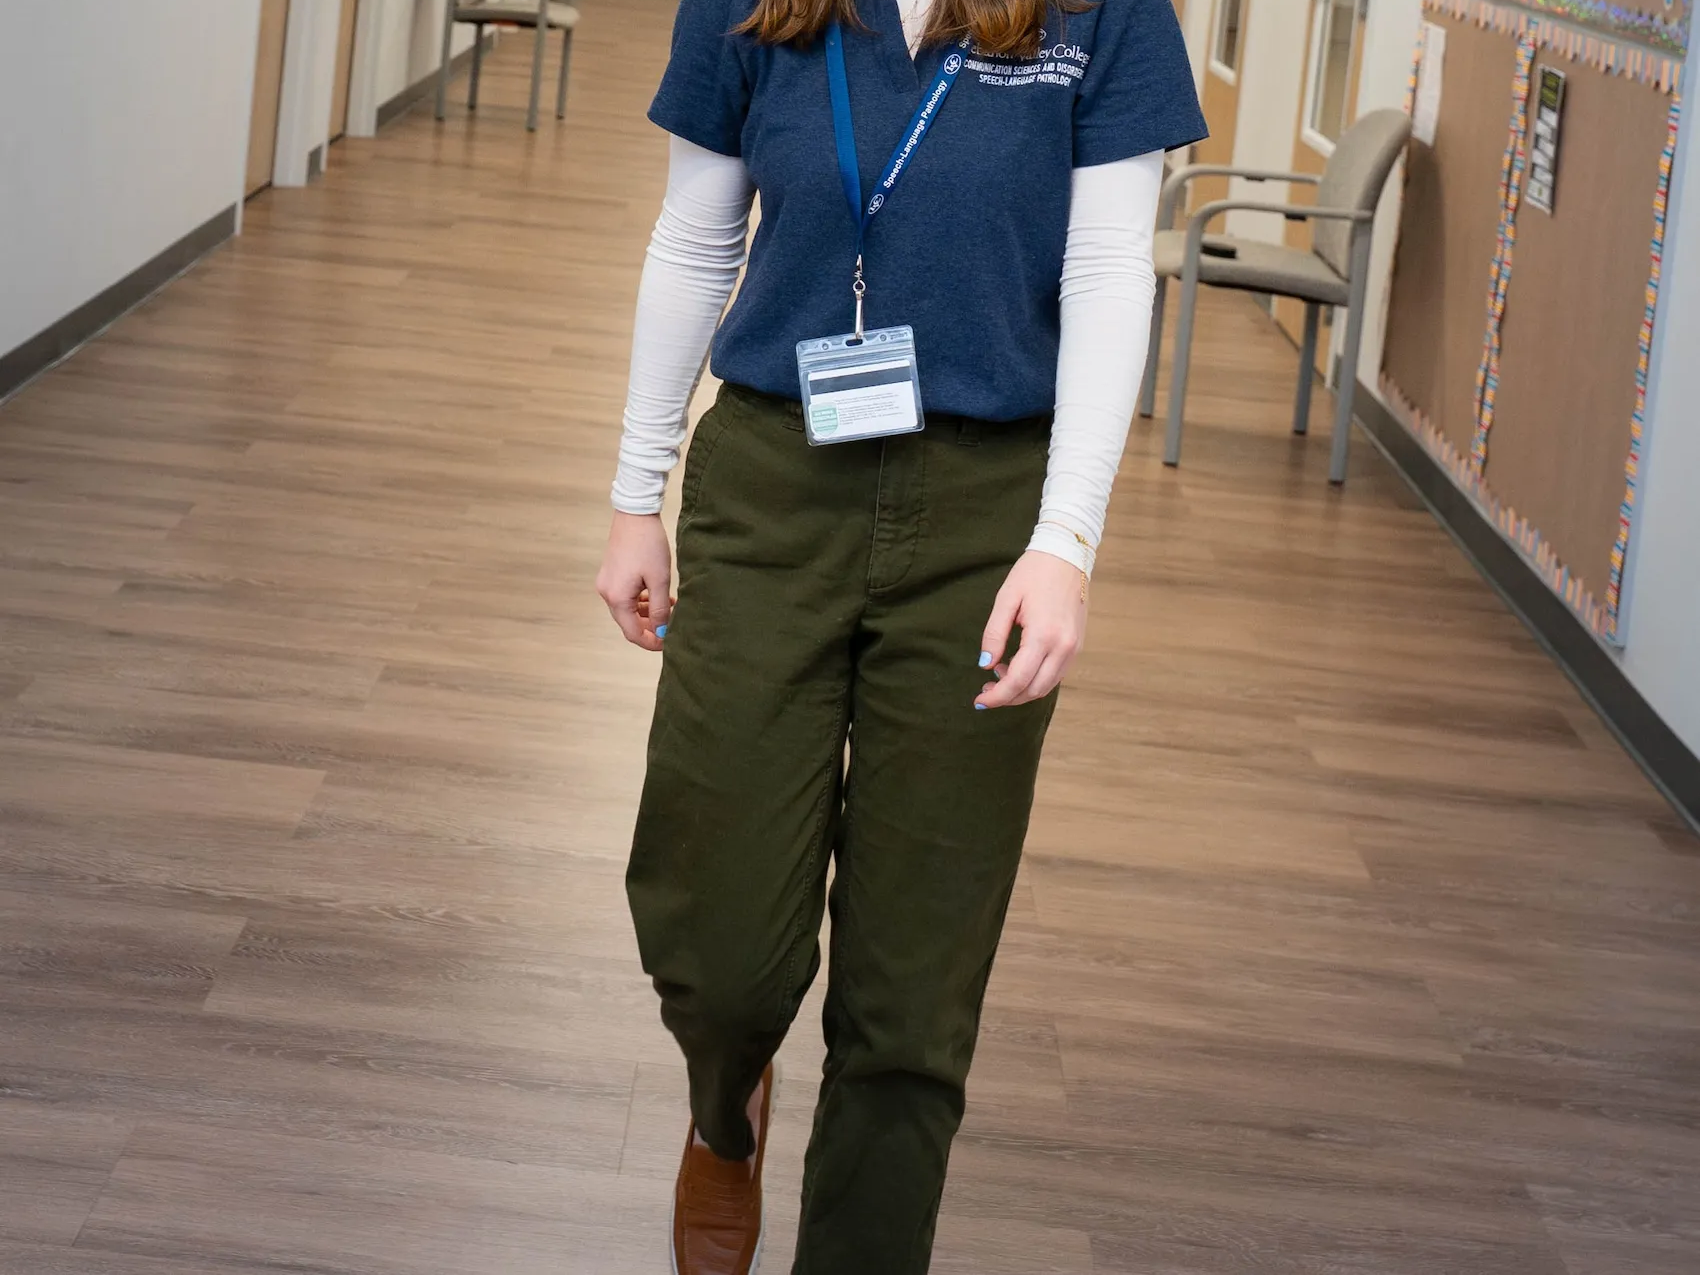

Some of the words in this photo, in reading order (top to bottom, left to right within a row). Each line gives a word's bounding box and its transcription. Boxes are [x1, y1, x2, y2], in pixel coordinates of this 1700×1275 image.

[963, 59, 1013, 75] COMMUNICATION
[1013, 63, 1041, 75] SCIENCES
[1042, 62, 1055, 72] AND
[1036, 72, 1072, 87] PATHOLOGY
[883, 118, 926, 188] Speech-Language
[920, 79, 948, 119] Pathology
